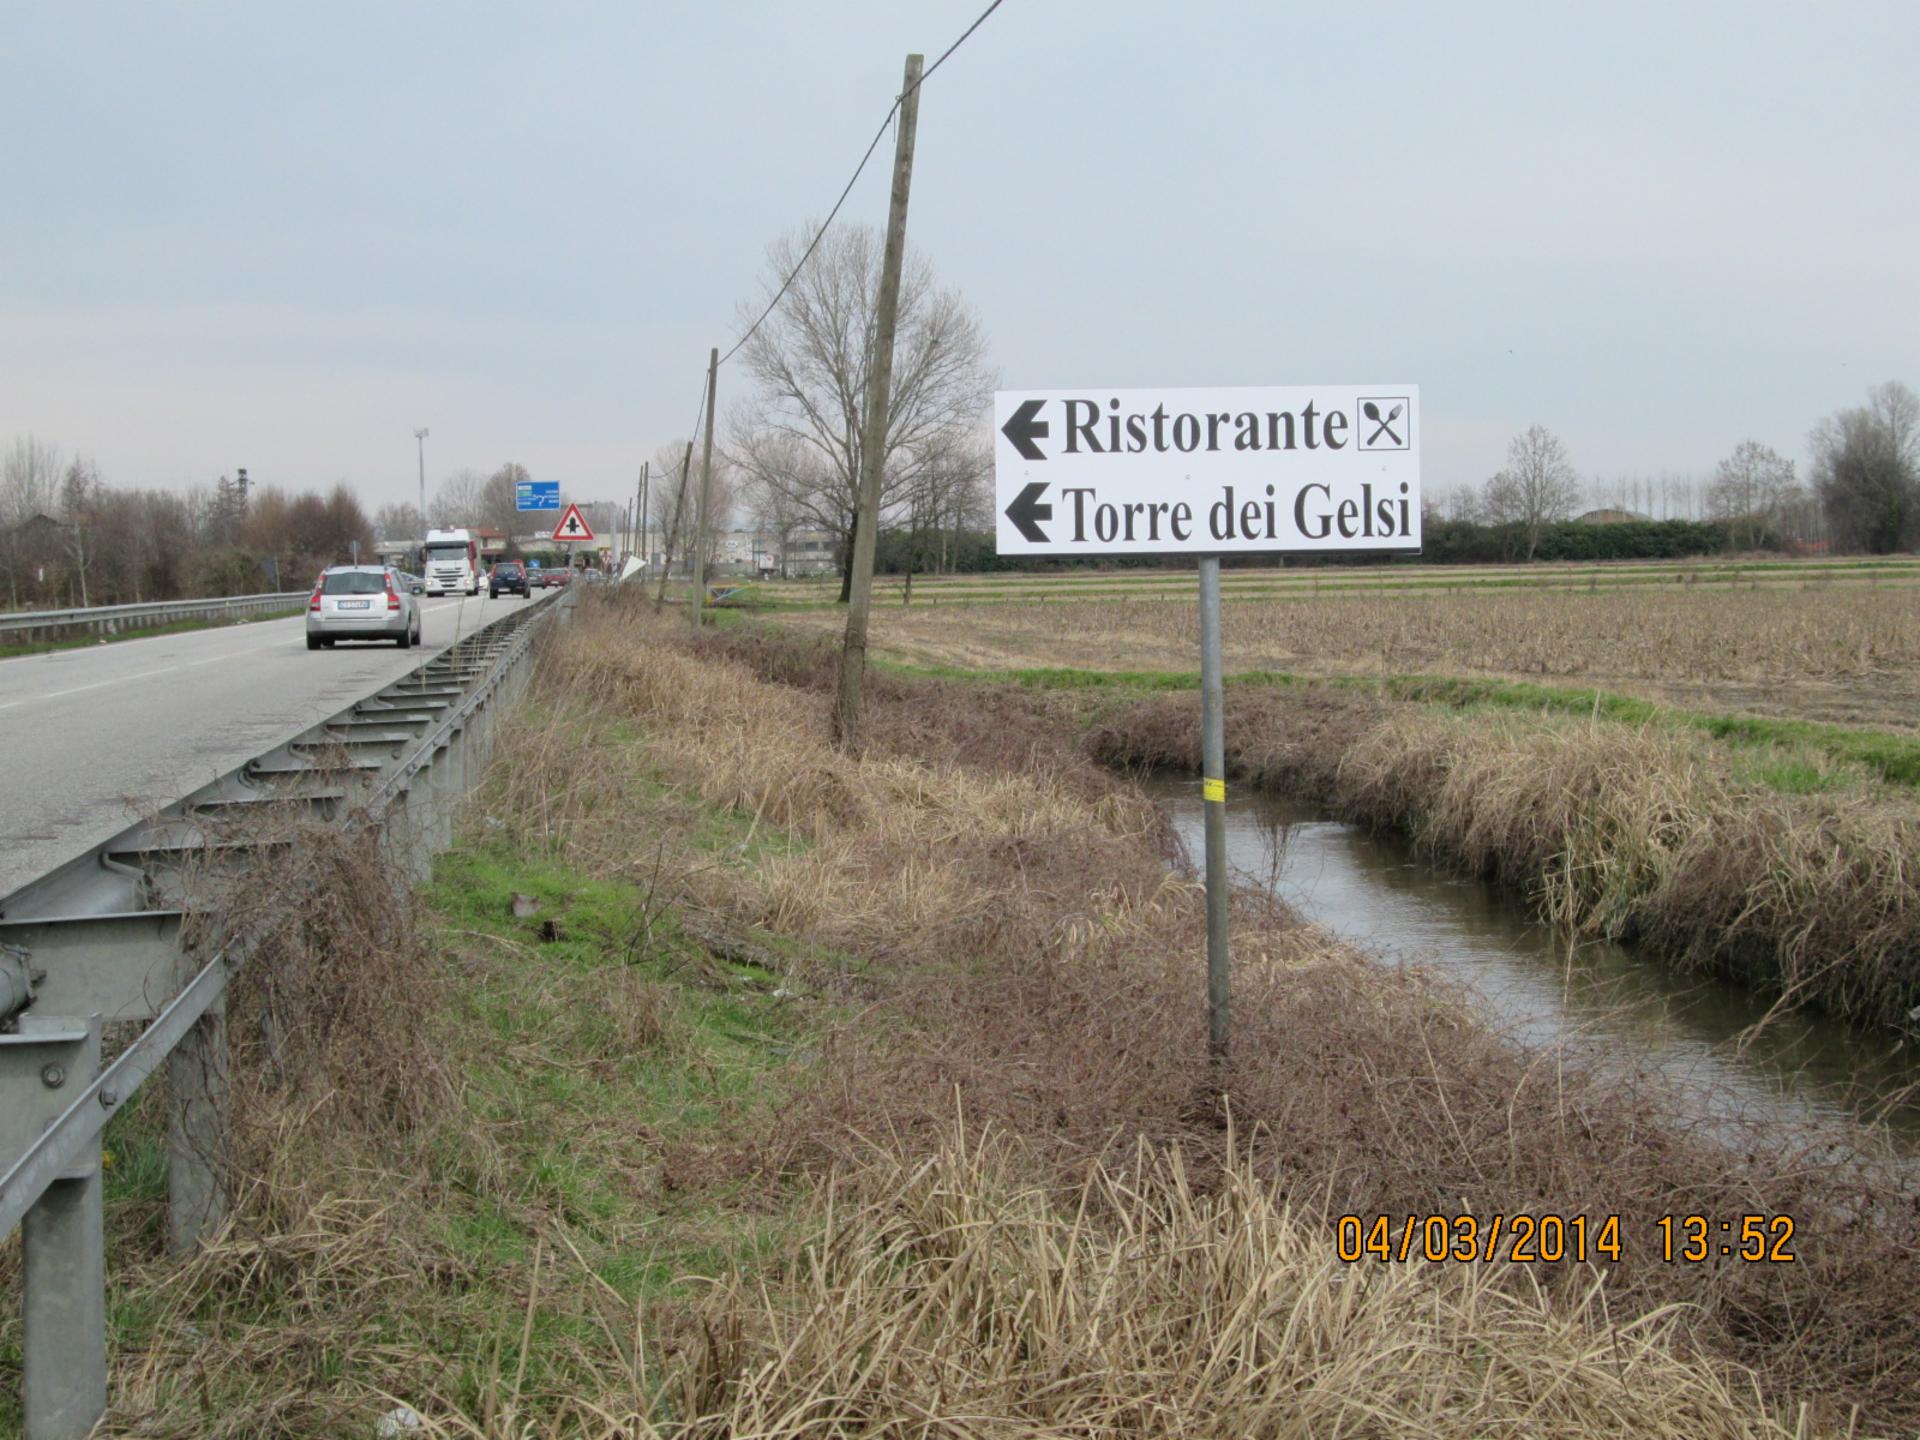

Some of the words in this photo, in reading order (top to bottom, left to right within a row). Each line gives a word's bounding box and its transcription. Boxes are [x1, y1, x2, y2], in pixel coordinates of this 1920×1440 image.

[1060, 397, 1349, 453] Ristorante
[1061, 487, 1193, 543] Torre
[1208, 483, 1279, 541] dei
[1293, 481, 1412, 540] Gelsi
